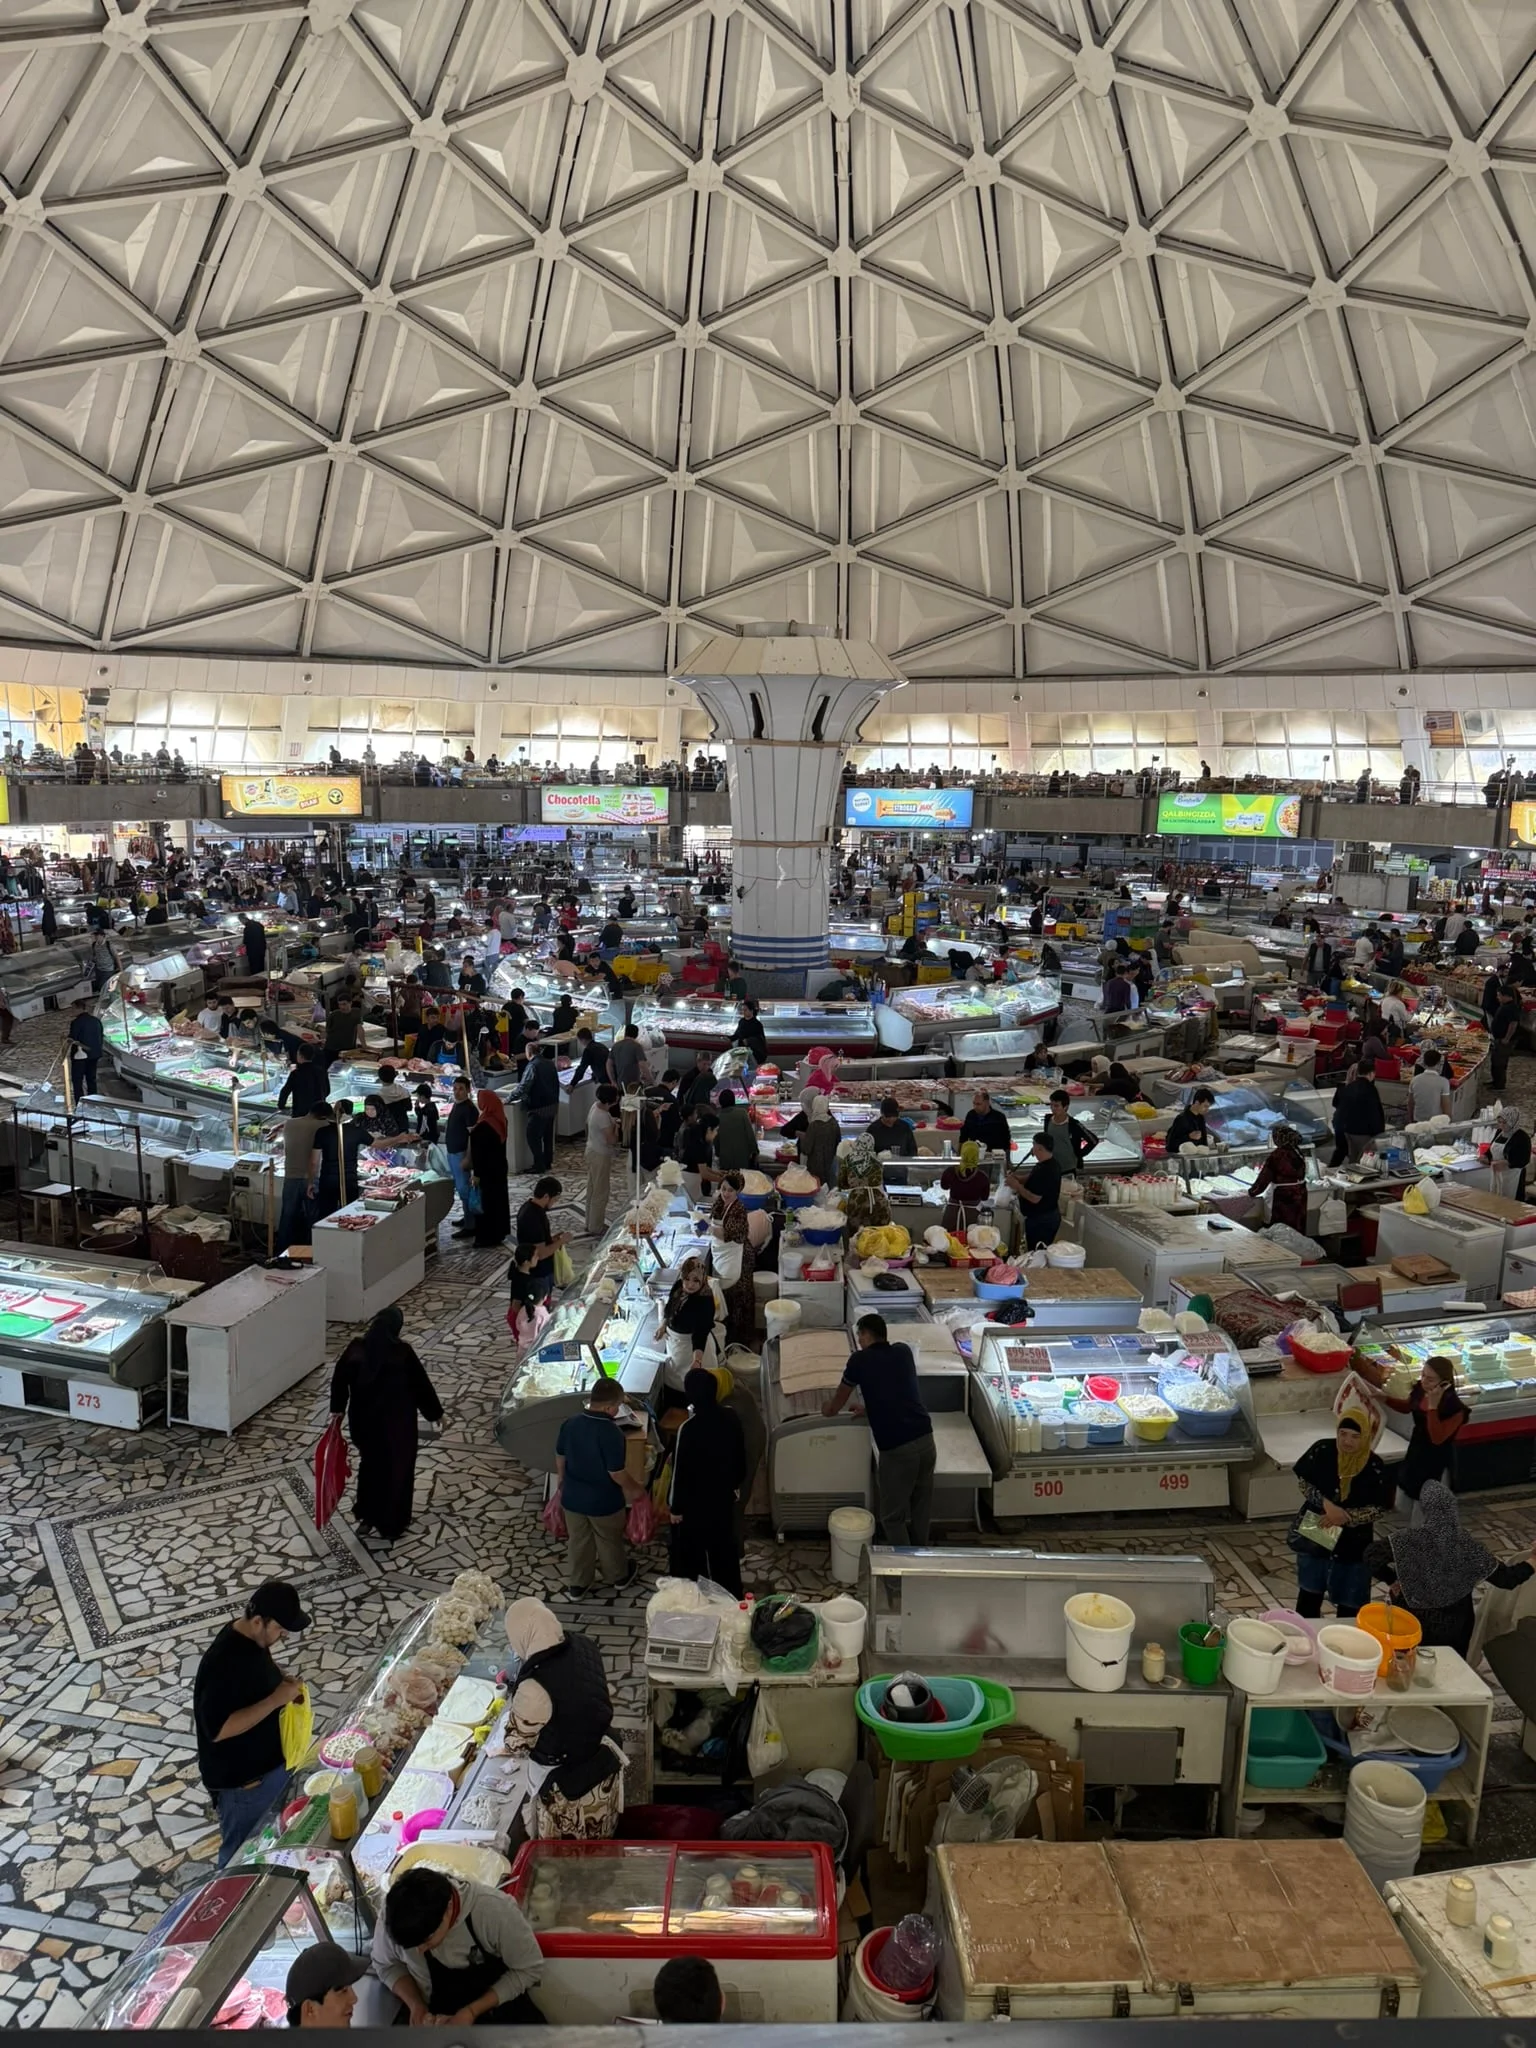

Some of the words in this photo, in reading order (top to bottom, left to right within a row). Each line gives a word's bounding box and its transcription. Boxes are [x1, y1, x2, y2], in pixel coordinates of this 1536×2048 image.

[548, 794, 600, 805] Chocotella
[77, 1393, 100, 1409] 273
[1034, 1480, 1063, 1497] 500
[1159, 1473, 1189, 1490] 499
